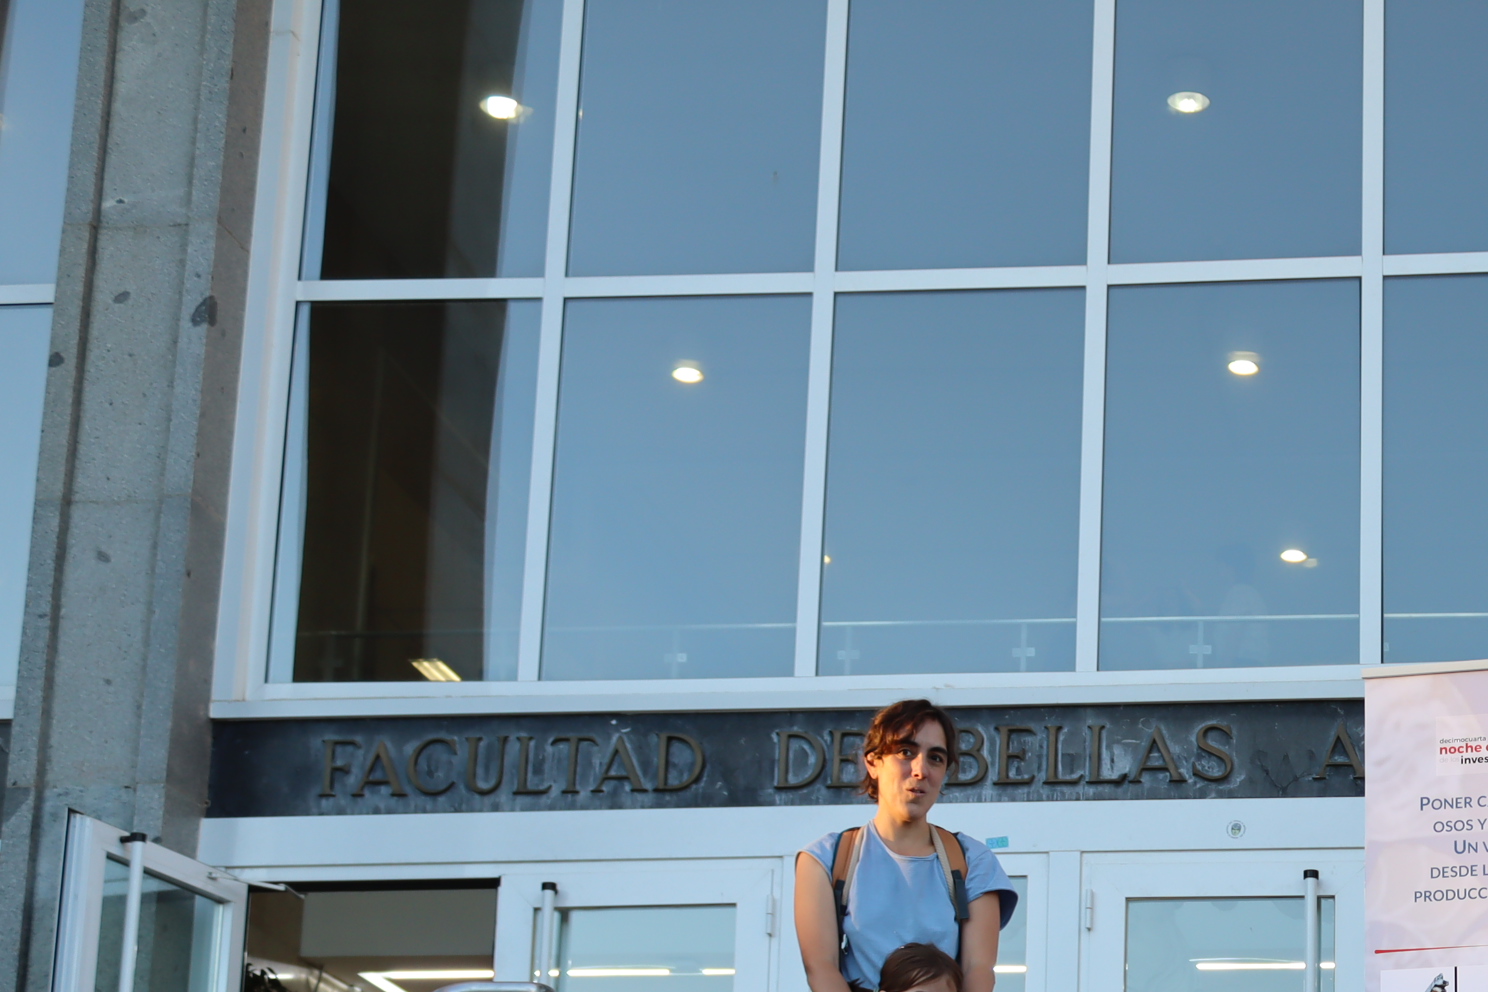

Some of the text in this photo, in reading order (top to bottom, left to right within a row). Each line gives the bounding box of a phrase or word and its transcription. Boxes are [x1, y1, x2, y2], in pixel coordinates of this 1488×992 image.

[1440, 736, 1486, 744] decimocuarta
[1440, 742, 1482, 754] noche
[317, 724, 1233, 798] FACULTAD DE BELLAS
[1420, 796, 1473, 811] PONER
[1433, 819, 1474, 833] OSOS
[1477, 818, 1487, 830] Y
[1454, 840, 1478, 854] UN
[1430, 864, 1478, 879] DESDE
